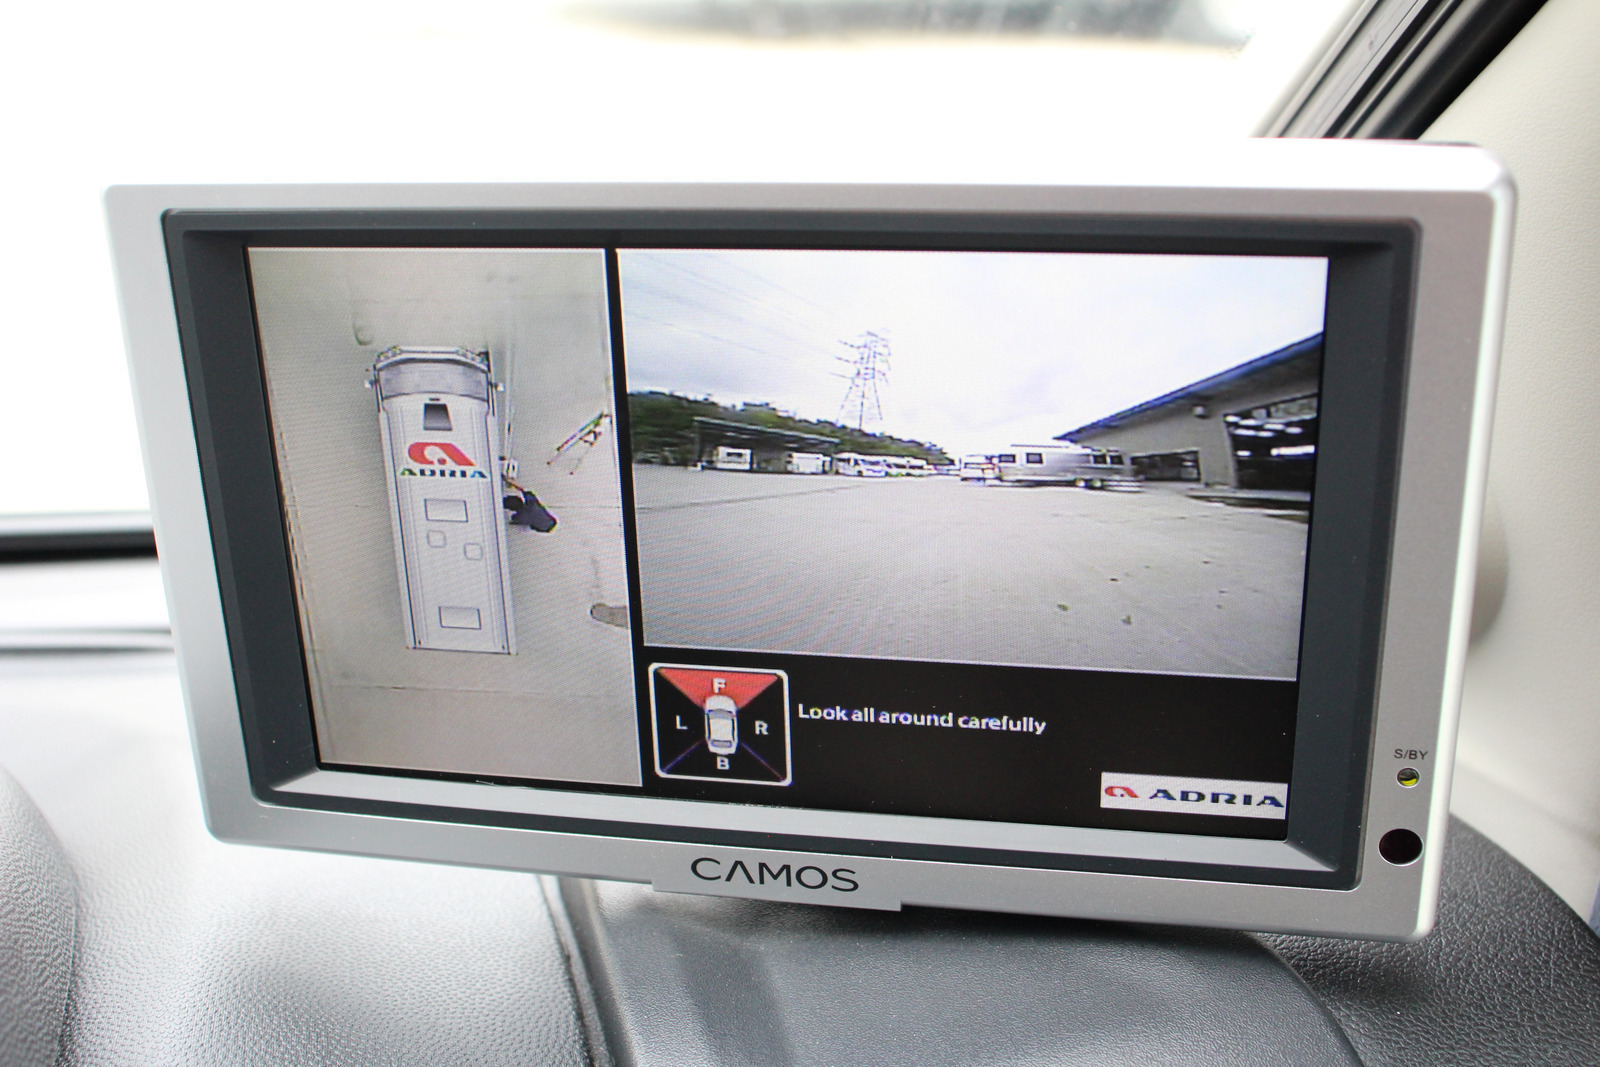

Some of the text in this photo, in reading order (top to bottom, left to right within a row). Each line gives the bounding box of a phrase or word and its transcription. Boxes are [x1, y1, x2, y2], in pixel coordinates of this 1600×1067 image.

[400, 467, 487, 479] ADRIA
[713, 678, 726, 694] F
[675, 715, 688, 730] L
[798, 703, 1047, 735] Look all around carefully
[754, 720, 769, 736] R
[1393, 748, 1428, 761] S/BY
[716, 756, 730, 770] B
[1149, 788, 1284, 808] ADRIA
[690, 857, 859, 892] CAMOS
